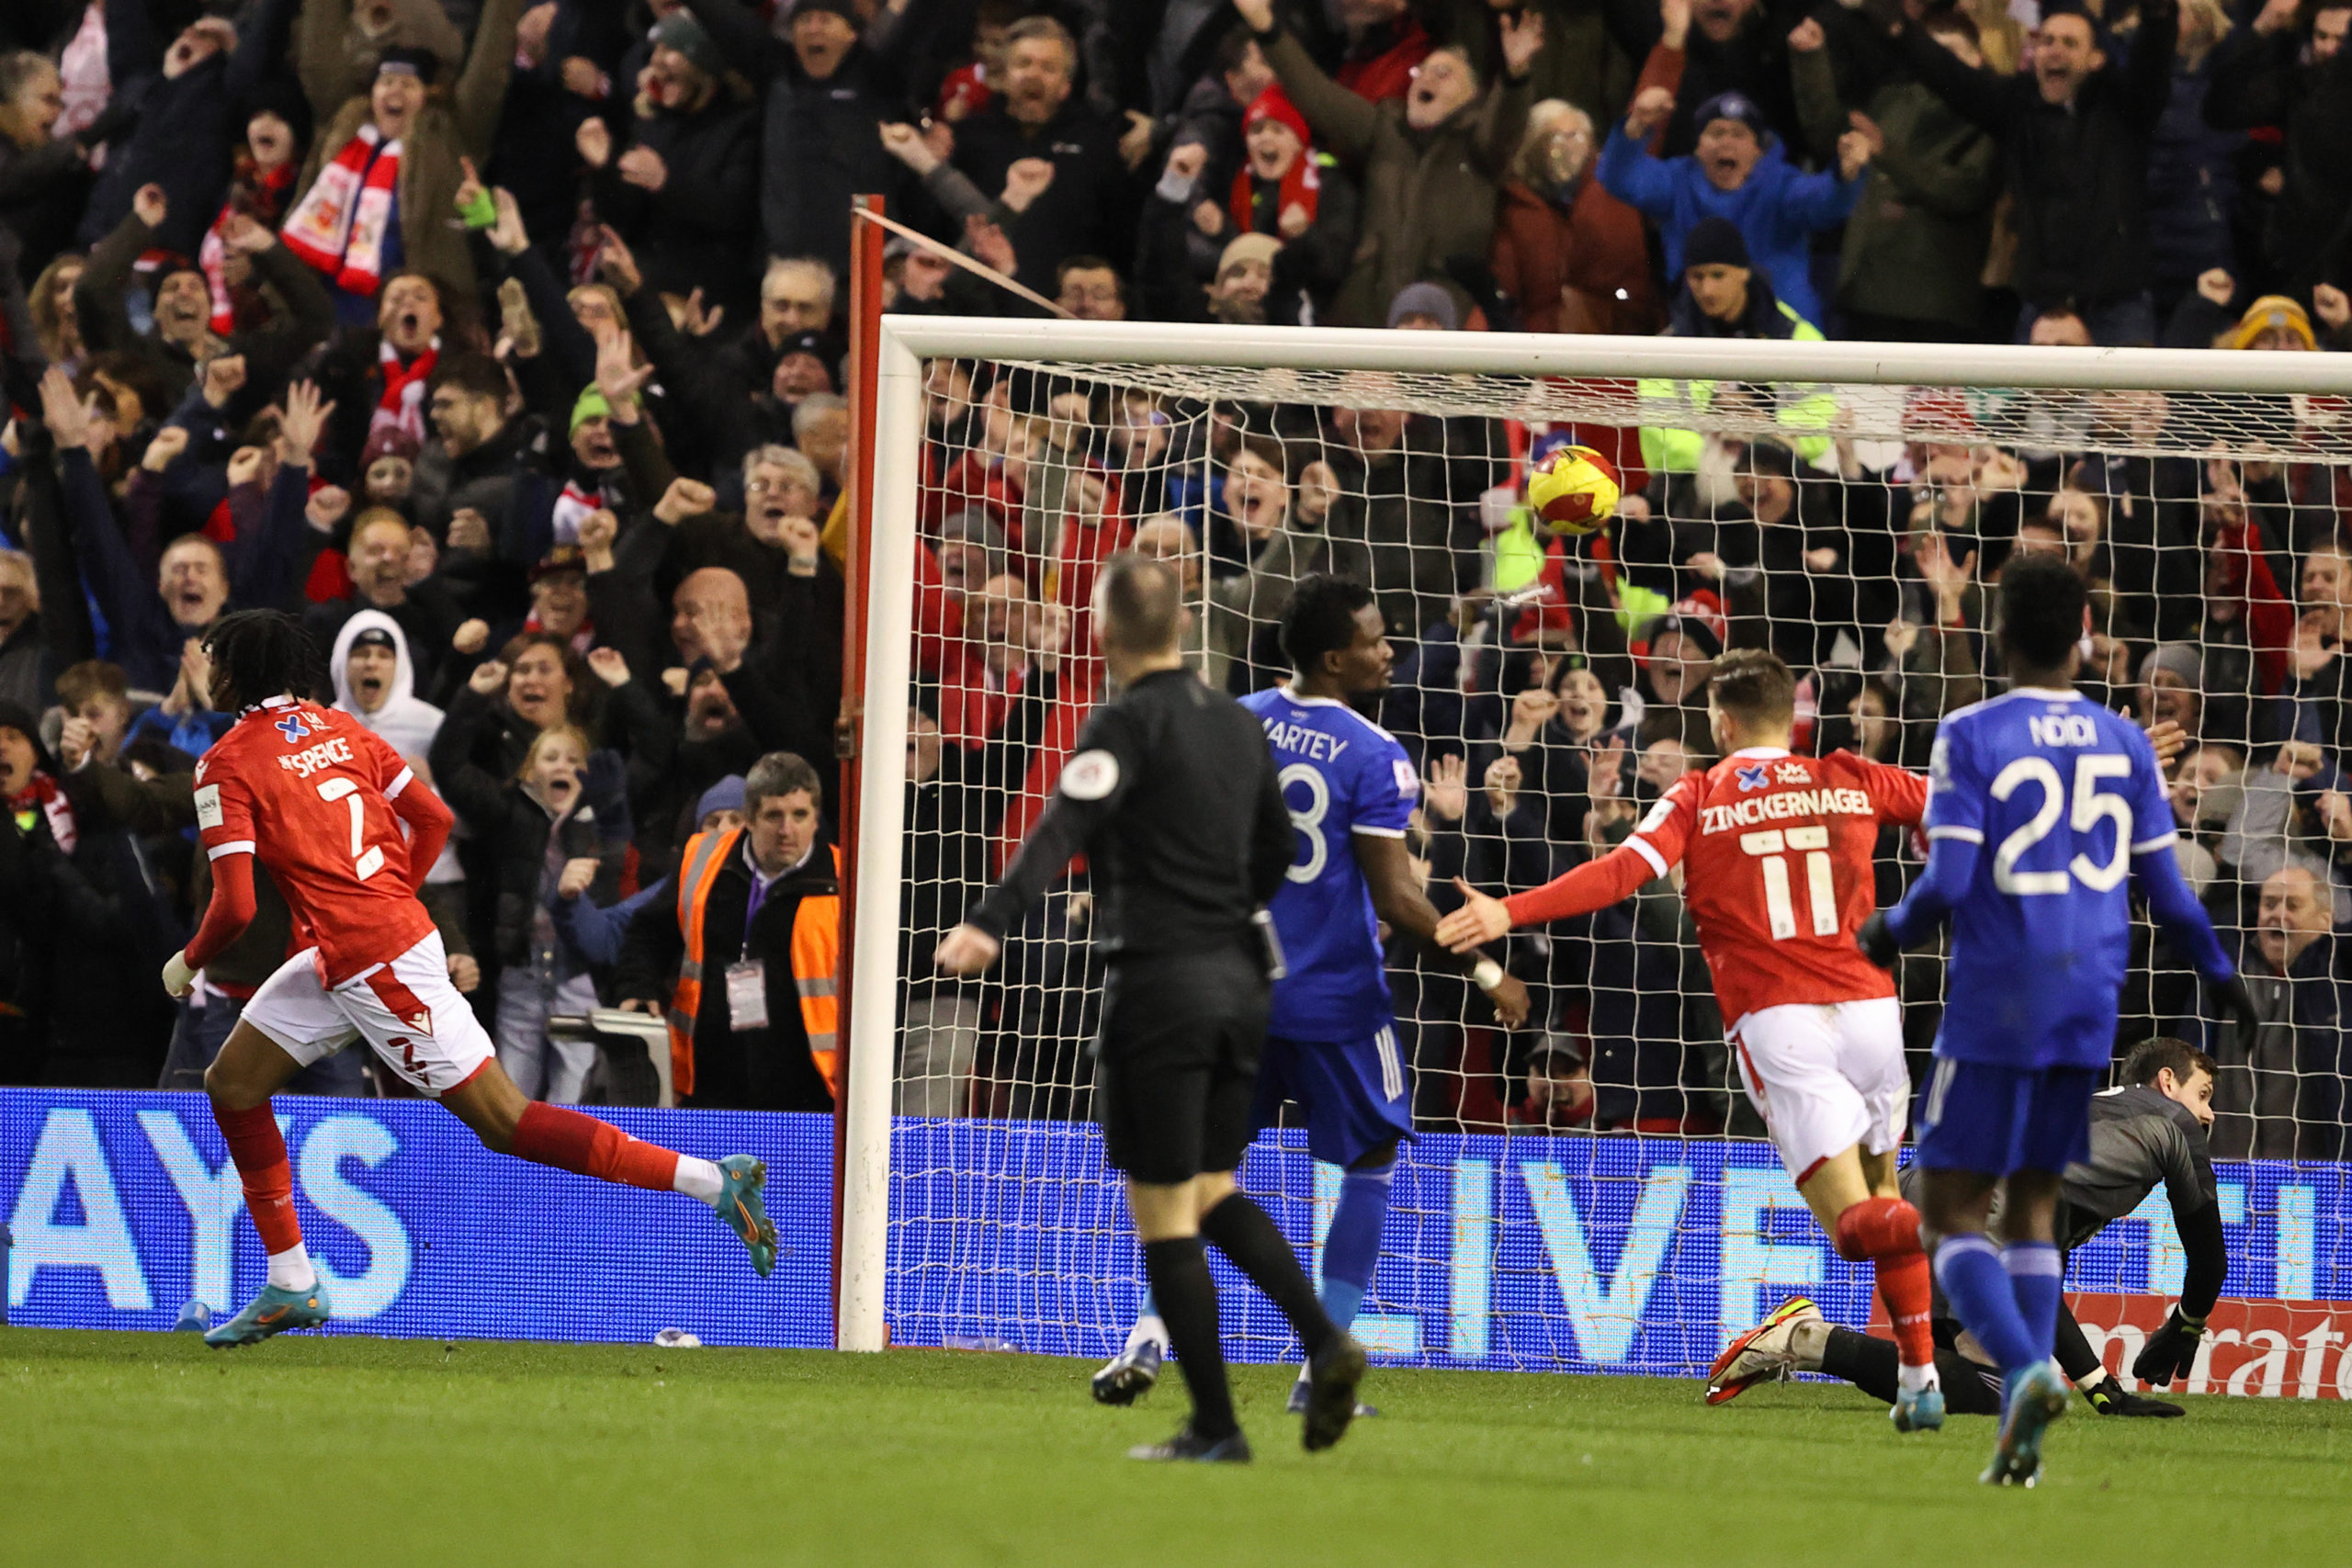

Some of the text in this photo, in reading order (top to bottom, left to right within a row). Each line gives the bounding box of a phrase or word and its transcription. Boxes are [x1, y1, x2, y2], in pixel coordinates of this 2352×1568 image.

[290, 738, 354, 778] SPENCE
[2028, 715, 2098, 748] NDIDI
[315, 776, 385, 882] 2
[1702, 788, 1874, 836] ZINCKERNAGEL
[1989, 753, 2134, 896] 25
[1739, 825, 1839, 942] 11
[7, 1107, 413, 1321] AYS
[2048, 1301, 2352, 1401] mrat
